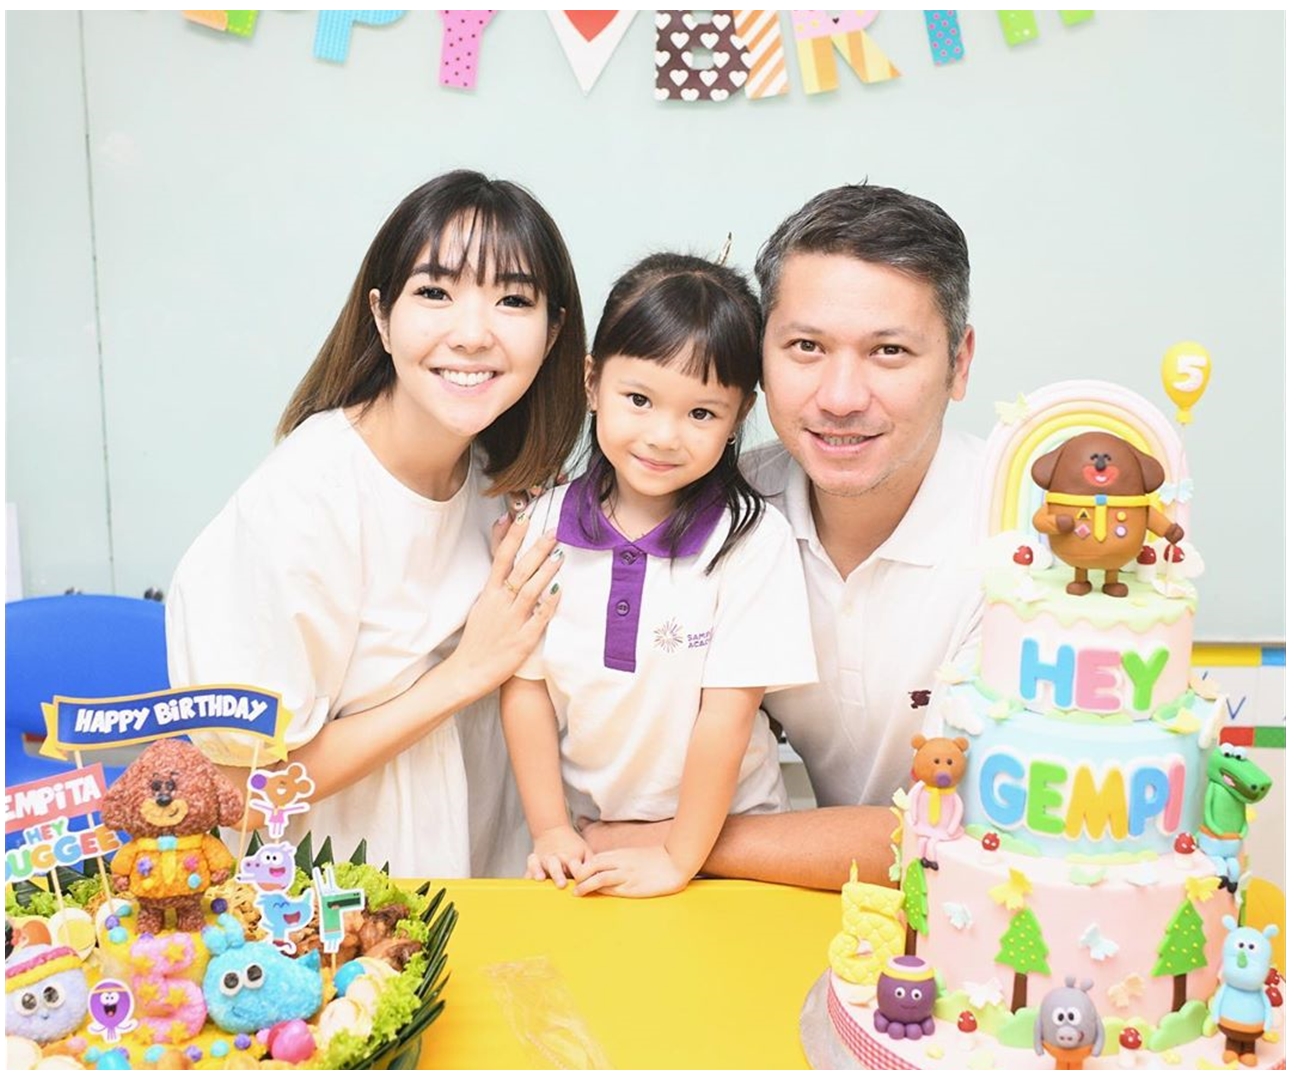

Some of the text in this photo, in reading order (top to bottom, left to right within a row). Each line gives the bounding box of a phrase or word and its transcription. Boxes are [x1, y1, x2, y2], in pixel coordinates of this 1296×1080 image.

[1172, 355, 1208, 393] 5
[1019, 638, 1170, 712] HEY
[74, 694, 268, 734] HAPPY BiRTHDAY
[979, 752, 1186, 840] GEMPI
[24, 817, 66, 845] HEY
[828, 881, 906, 986] 5
